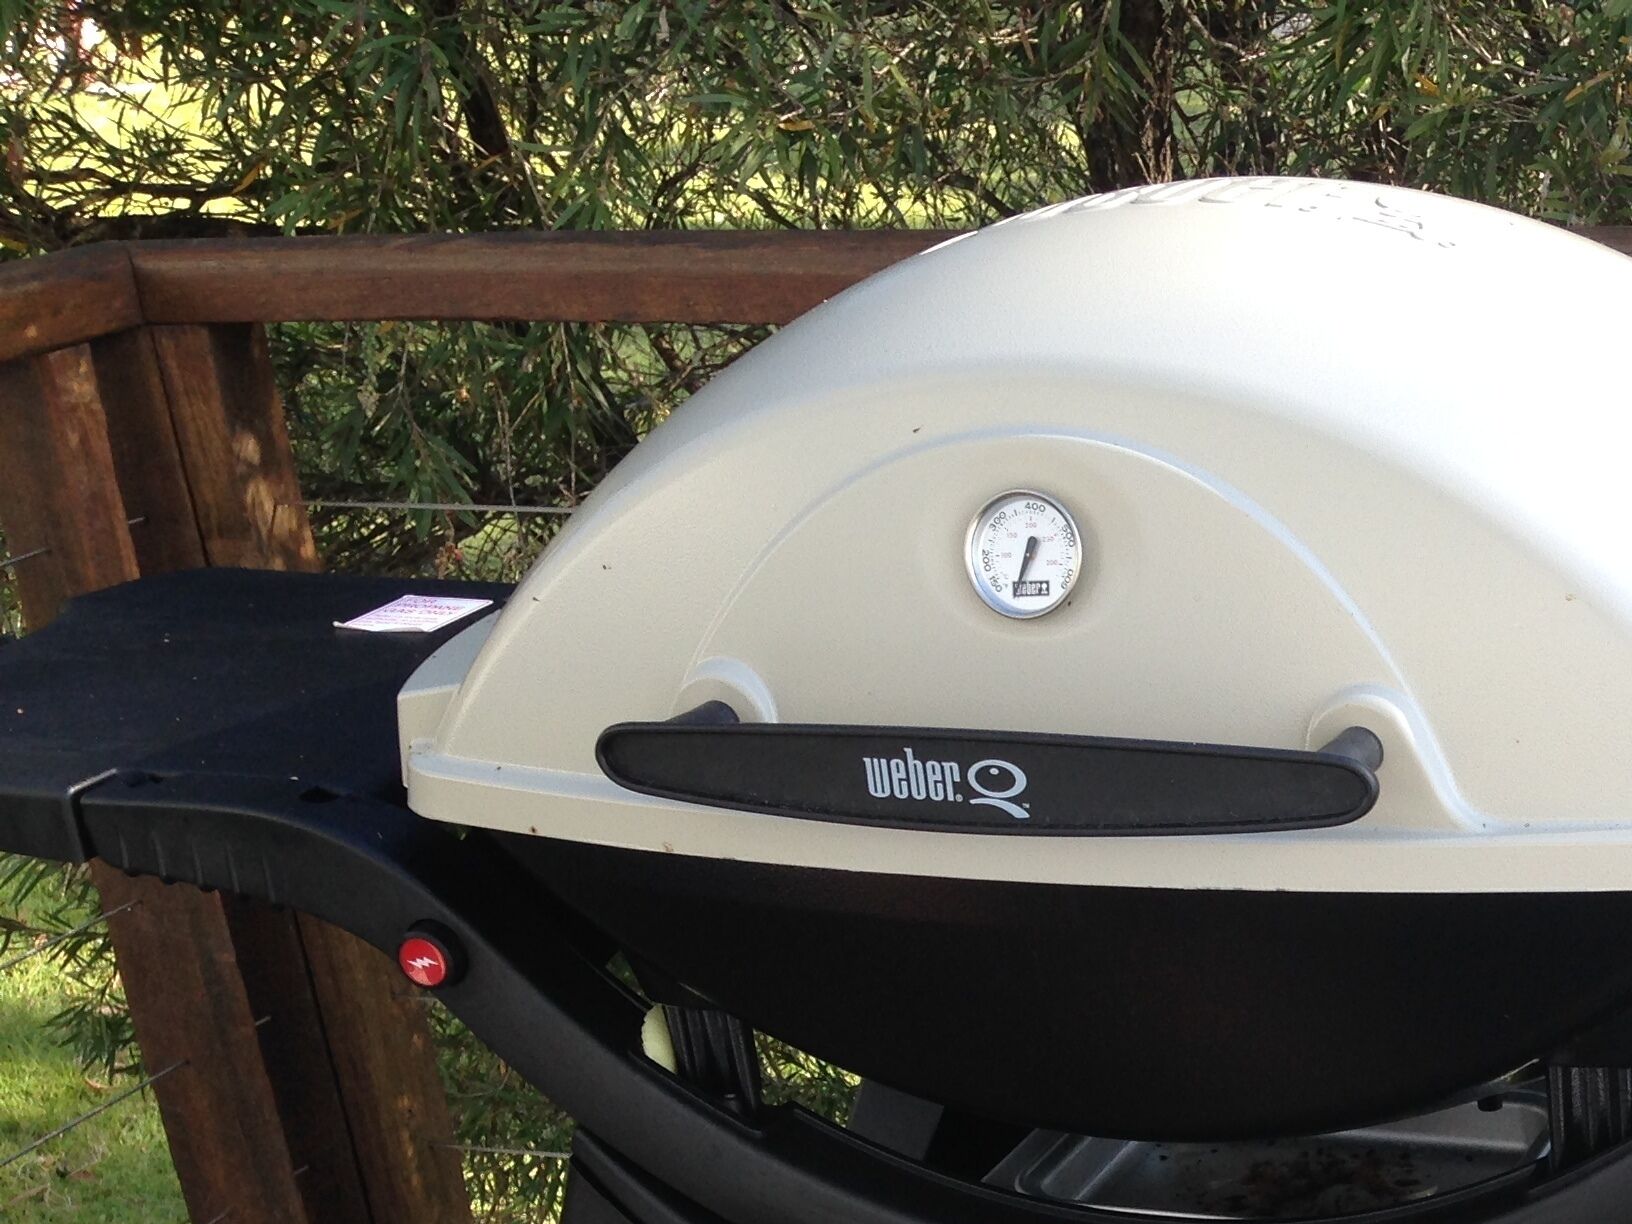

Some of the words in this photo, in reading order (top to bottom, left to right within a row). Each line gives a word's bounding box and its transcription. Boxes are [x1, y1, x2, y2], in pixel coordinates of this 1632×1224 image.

[1025, 502, 1046, 513] 400
[989, 511, 1007, 532] 300
[1061, 524, 1076, 548] 500
[982, 549, 992, 572] 200
[989, 575, 1003, 593] 150
[1060, 568, 1074, 590] 600
[863, 747, 961, 801] weber
[967, 759, 1030, 819] Q
